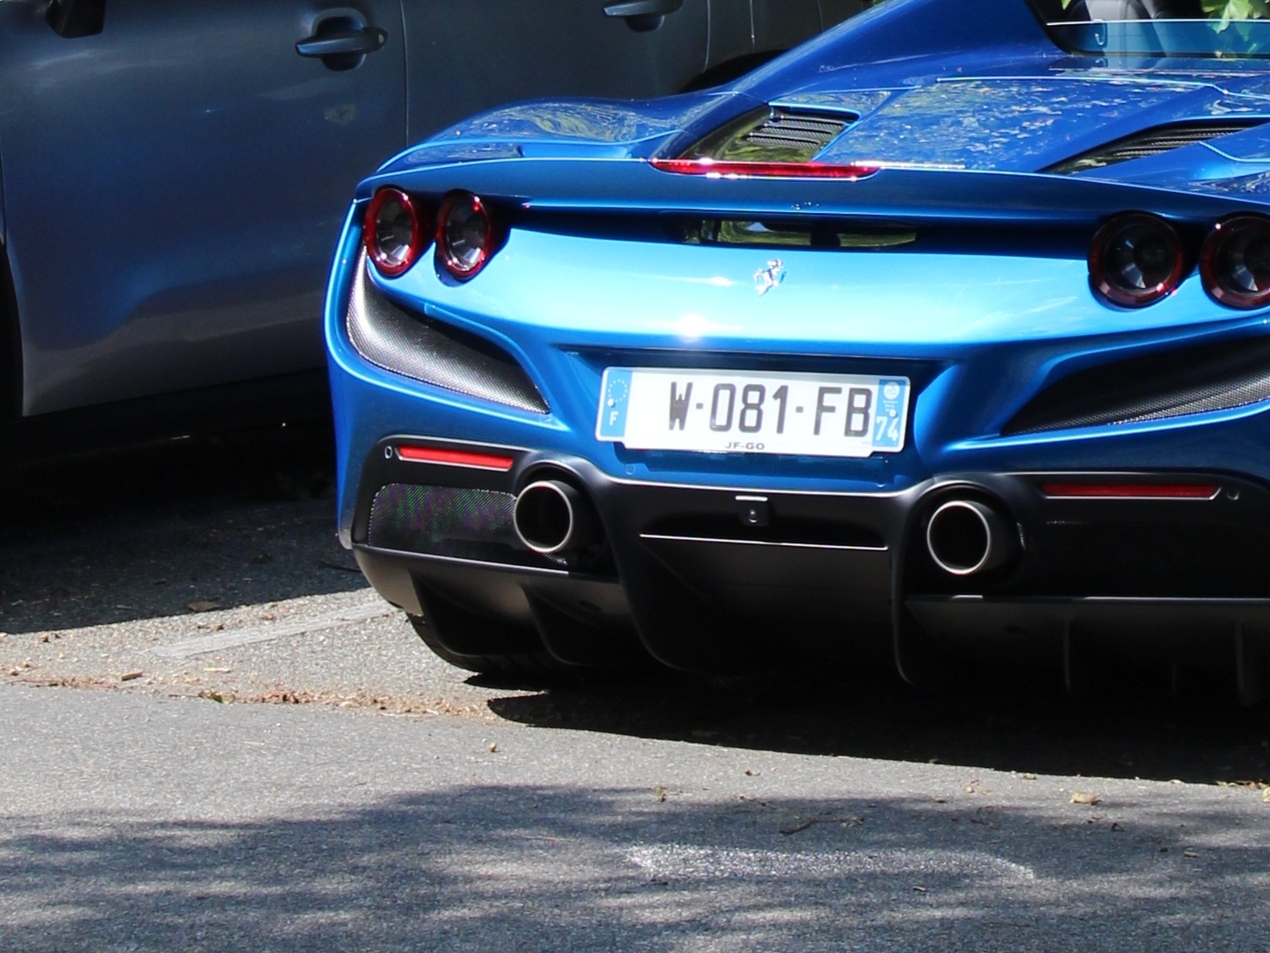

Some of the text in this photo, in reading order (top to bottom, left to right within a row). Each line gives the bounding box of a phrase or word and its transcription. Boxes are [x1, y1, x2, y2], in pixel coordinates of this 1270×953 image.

[609, 410, 619, 426] F
[668, 381, 873, 438] W-081-FB
[875, 415, 899, 441] 74
